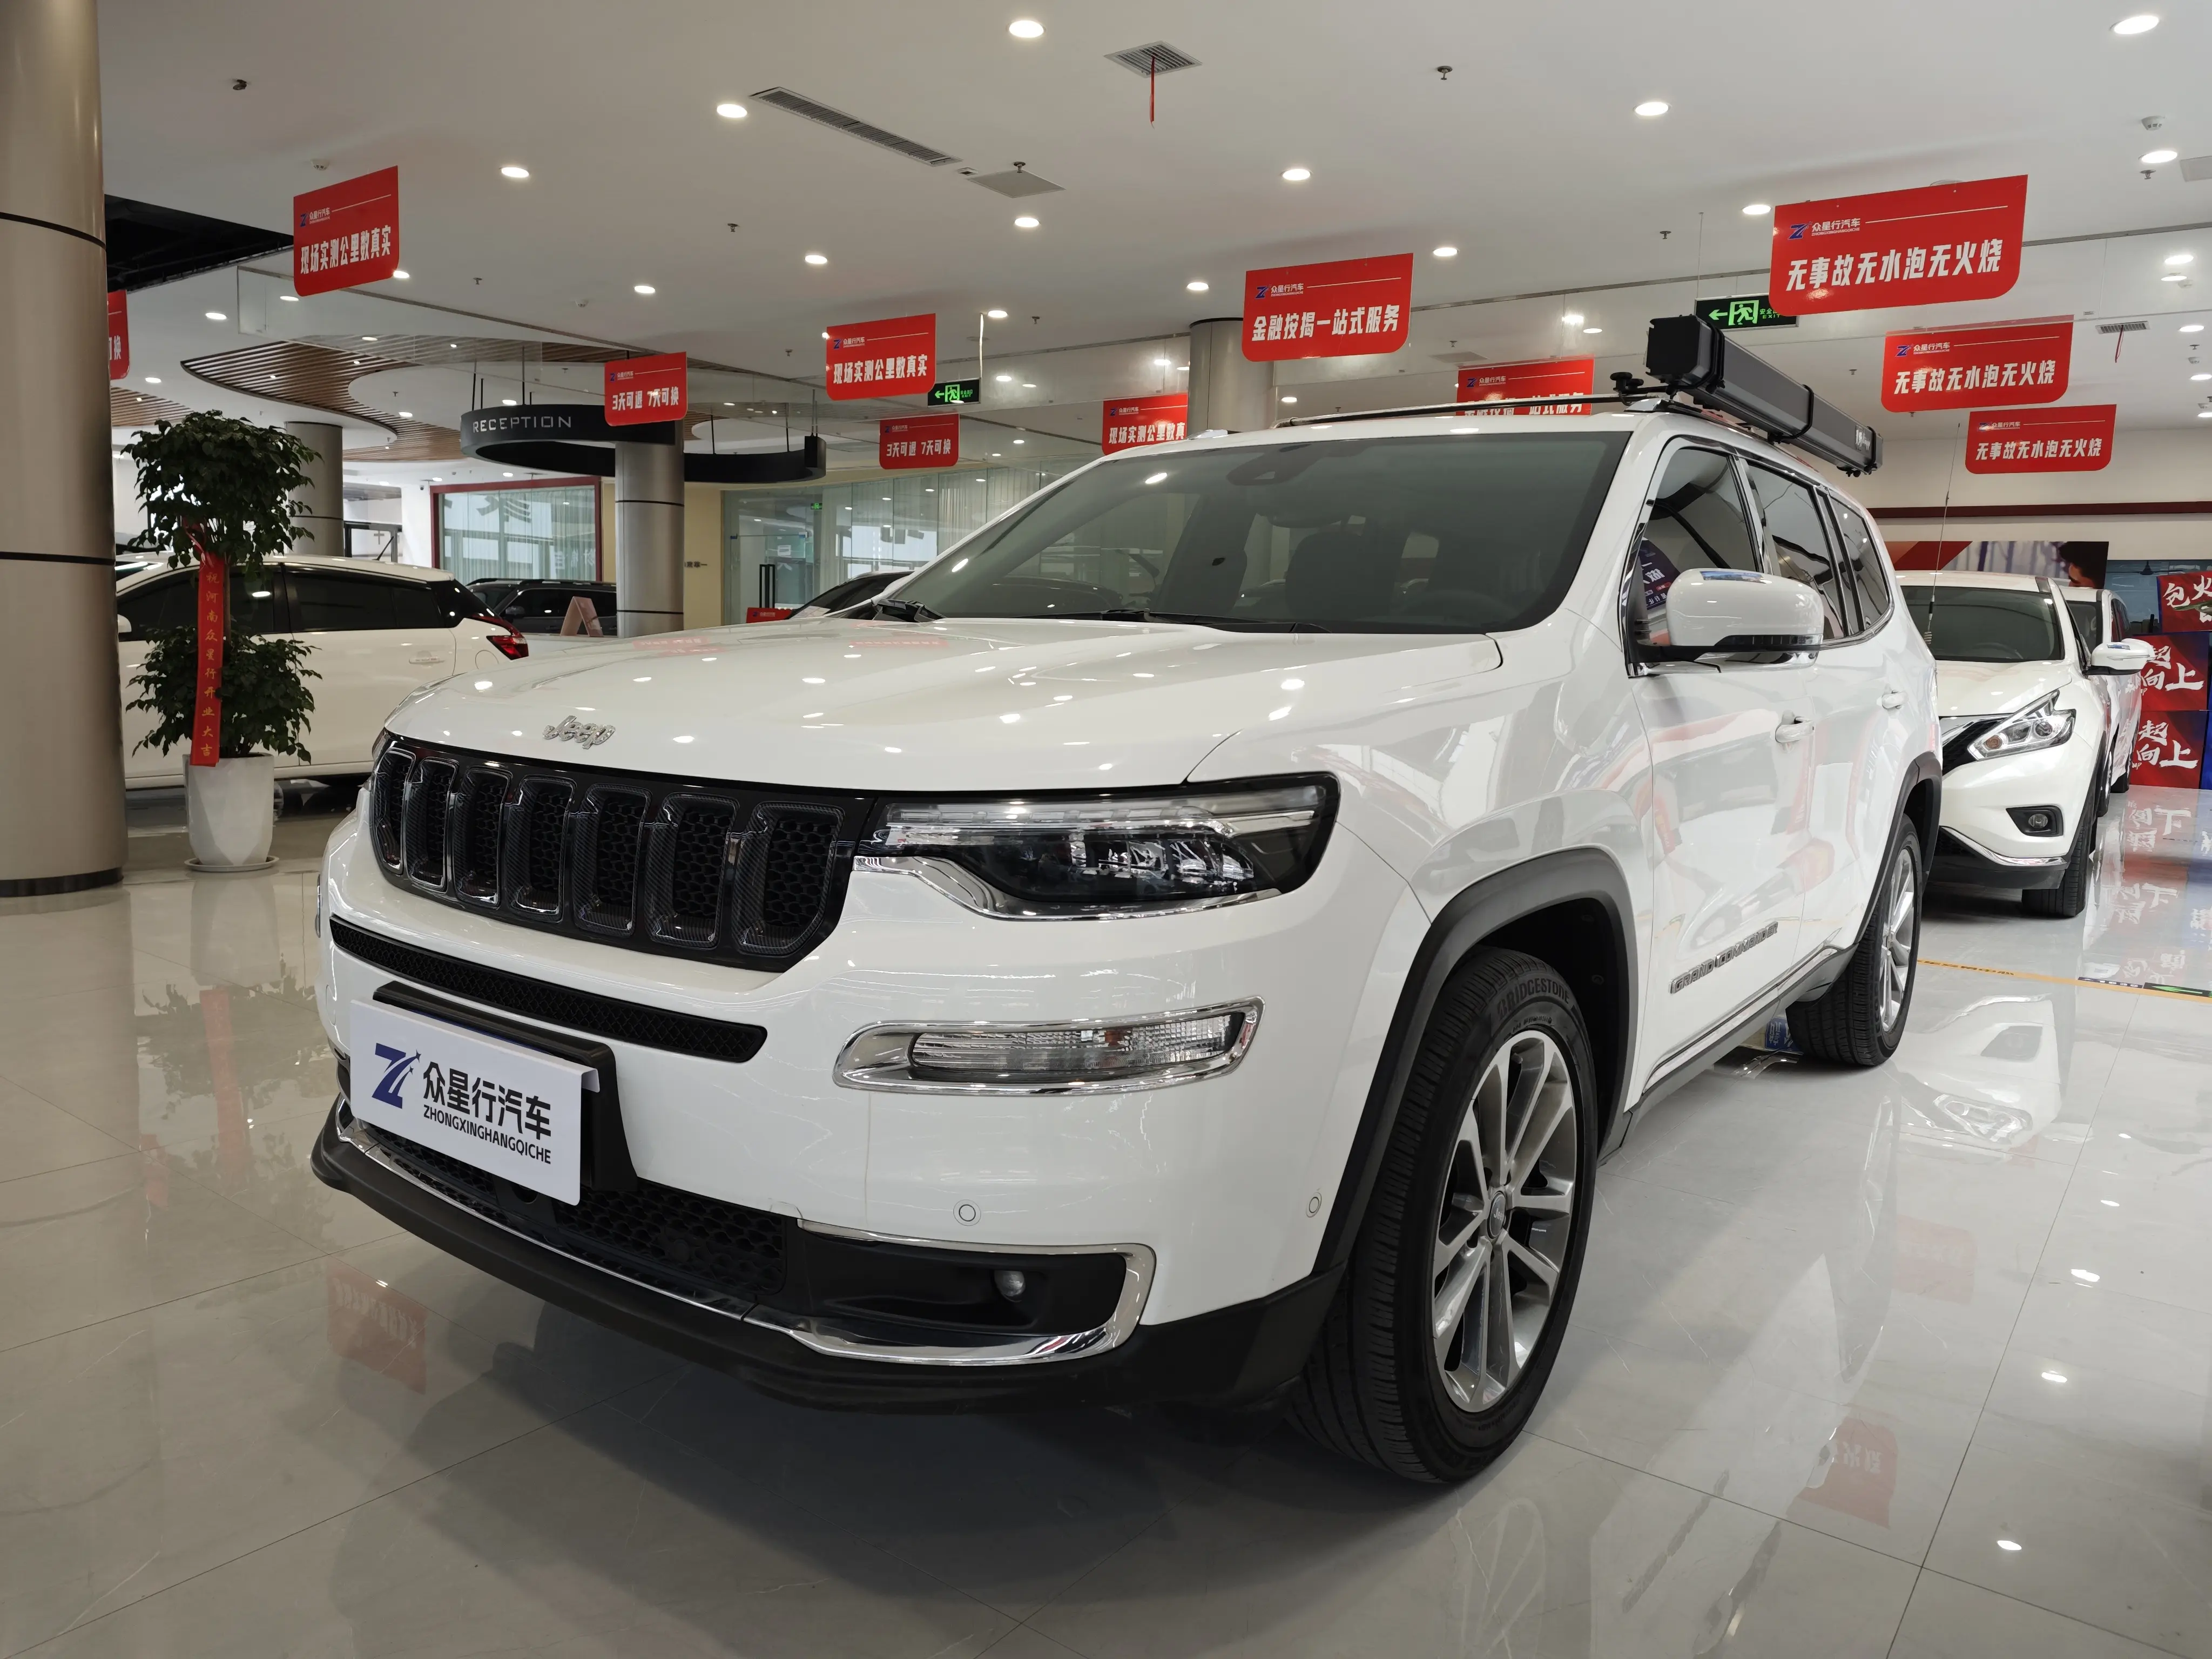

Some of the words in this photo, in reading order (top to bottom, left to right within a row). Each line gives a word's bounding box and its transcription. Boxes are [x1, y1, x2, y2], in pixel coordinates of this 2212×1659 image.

[1812, 218, 1860, 232] 众星行汽车
[300, 225, 391, 274] 现场实测公里数真实
[1786, 238, 2004, 292] 无事故无水泡无火烧
[1271, 283, 1304, 293] 众星行汽车
[1251, 305, 1400, 341] 金融按揭一站式服务
[1913, 342, 1950, 352] 众星行汽车
[833, 354, 928, 384] 现场实测公里数真实
[1479, 376, 1506, 384] 众星行汽车
[1894, 360, 2056, 394] 无事故无水泡无火烧
[612, 390, 643, 411] 3天可退
[647, 386, 679, 407] 7天可换
[473, 416, 571, 433] RECEPTION
[1109, 422, 1185, 444] 现场实测公里数真
[886, 441, 916, 457] 3天可退
[921, 439, 951, 455] 7天可换
[1975, 439, 2102, 461] 无事故无水泡无火烧
[200, 571, 220, 757] 祝河南众星行开业大吉
[542, 715, 616, 750] Jeep
[1670, 958, 1715, 994] GRAND
[1714, 921, 1778, 968] COMMANDER
[1497, 978, 1569, 1019] BRIDGESTONE
[423, 1061, 551, 1140] 众星行汽车
[423, 1104, 551, 1165] ZHONGXINGHANGQICHE
